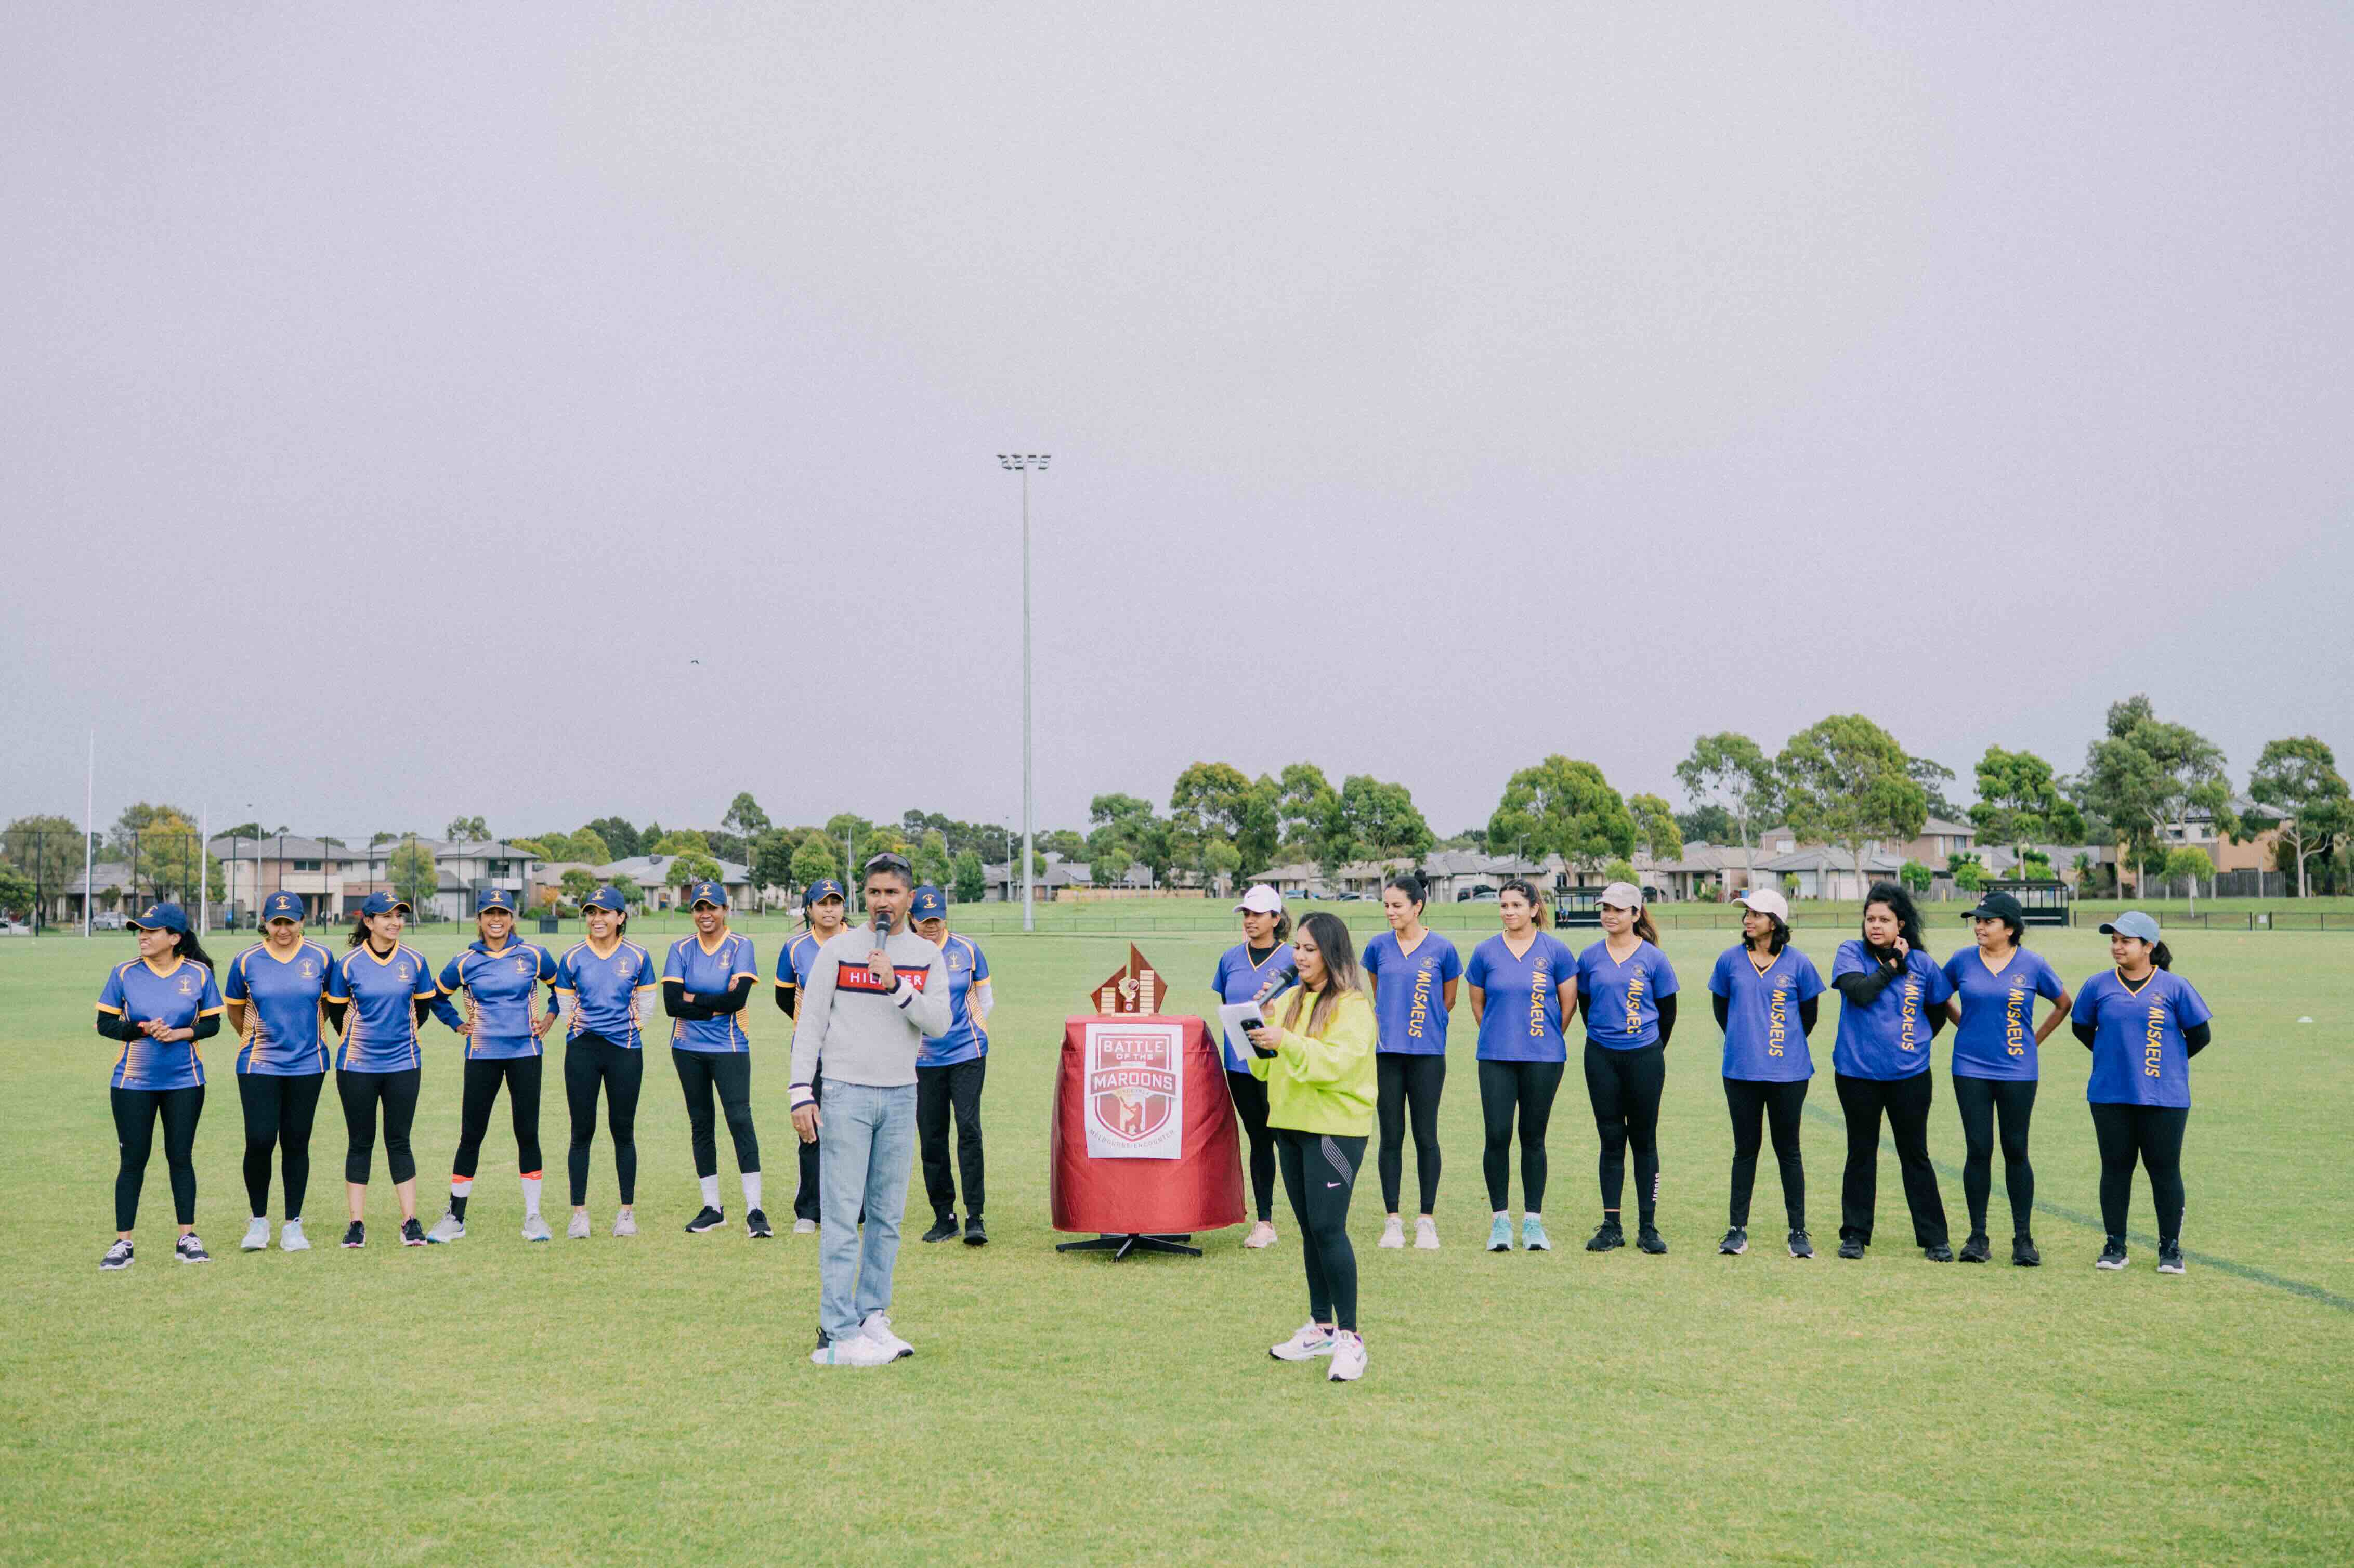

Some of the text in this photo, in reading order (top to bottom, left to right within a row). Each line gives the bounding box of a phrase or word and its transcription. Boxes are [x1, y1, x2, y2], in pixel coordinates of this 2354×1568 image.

[850, 972, 922, 986] HILER
[1408, 970, 1432, 1038] MUSAEUS
[1530, 971, 1547, 1037] MUSAEUS
[1103, 1040, 1165, 1053] BATTLE
[1769, 989, 1787, 1057] MUSAEUS
[1902, 984, 1919, 1051] MUSAEUS
[2007, 988, 2025, 1056] MUSAEUS
[2144, 1007, 2165, 1078] MUSAEUS
[1093, 1072, 1173, 1090] MAROONS
